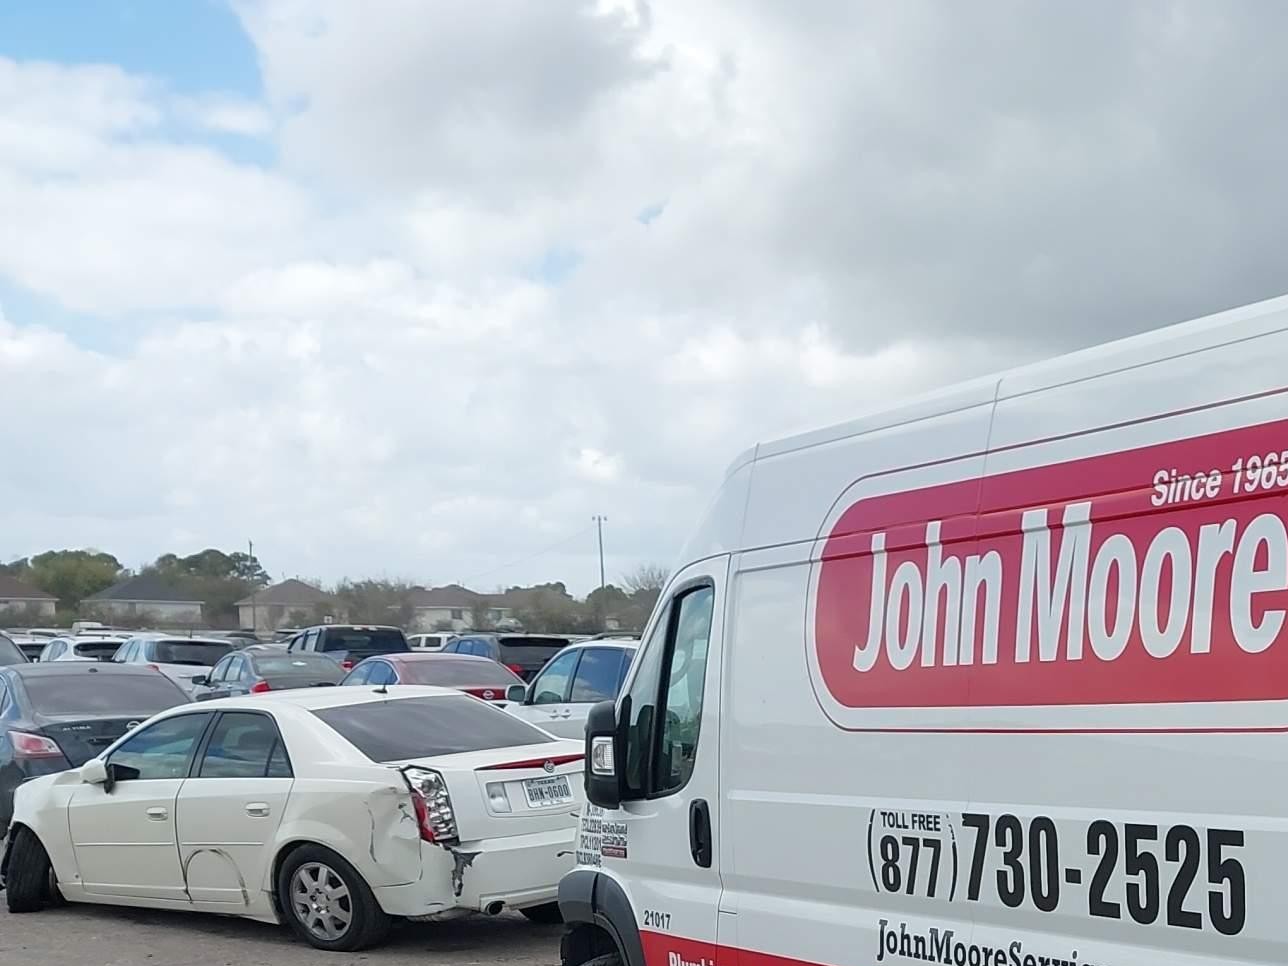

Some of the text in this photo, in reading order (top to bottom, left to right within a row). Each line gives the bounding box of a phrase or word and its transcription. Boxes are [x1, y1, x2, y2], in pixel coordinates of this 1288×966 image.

[1151, 463, 1222, 507] Since
[852, 519, 1002, 673] John
[880, 811, 941, 833] TOLL FREE
[962, 812, 1246, 936] 730-2525
[644, 910, 671, 930] 21017
